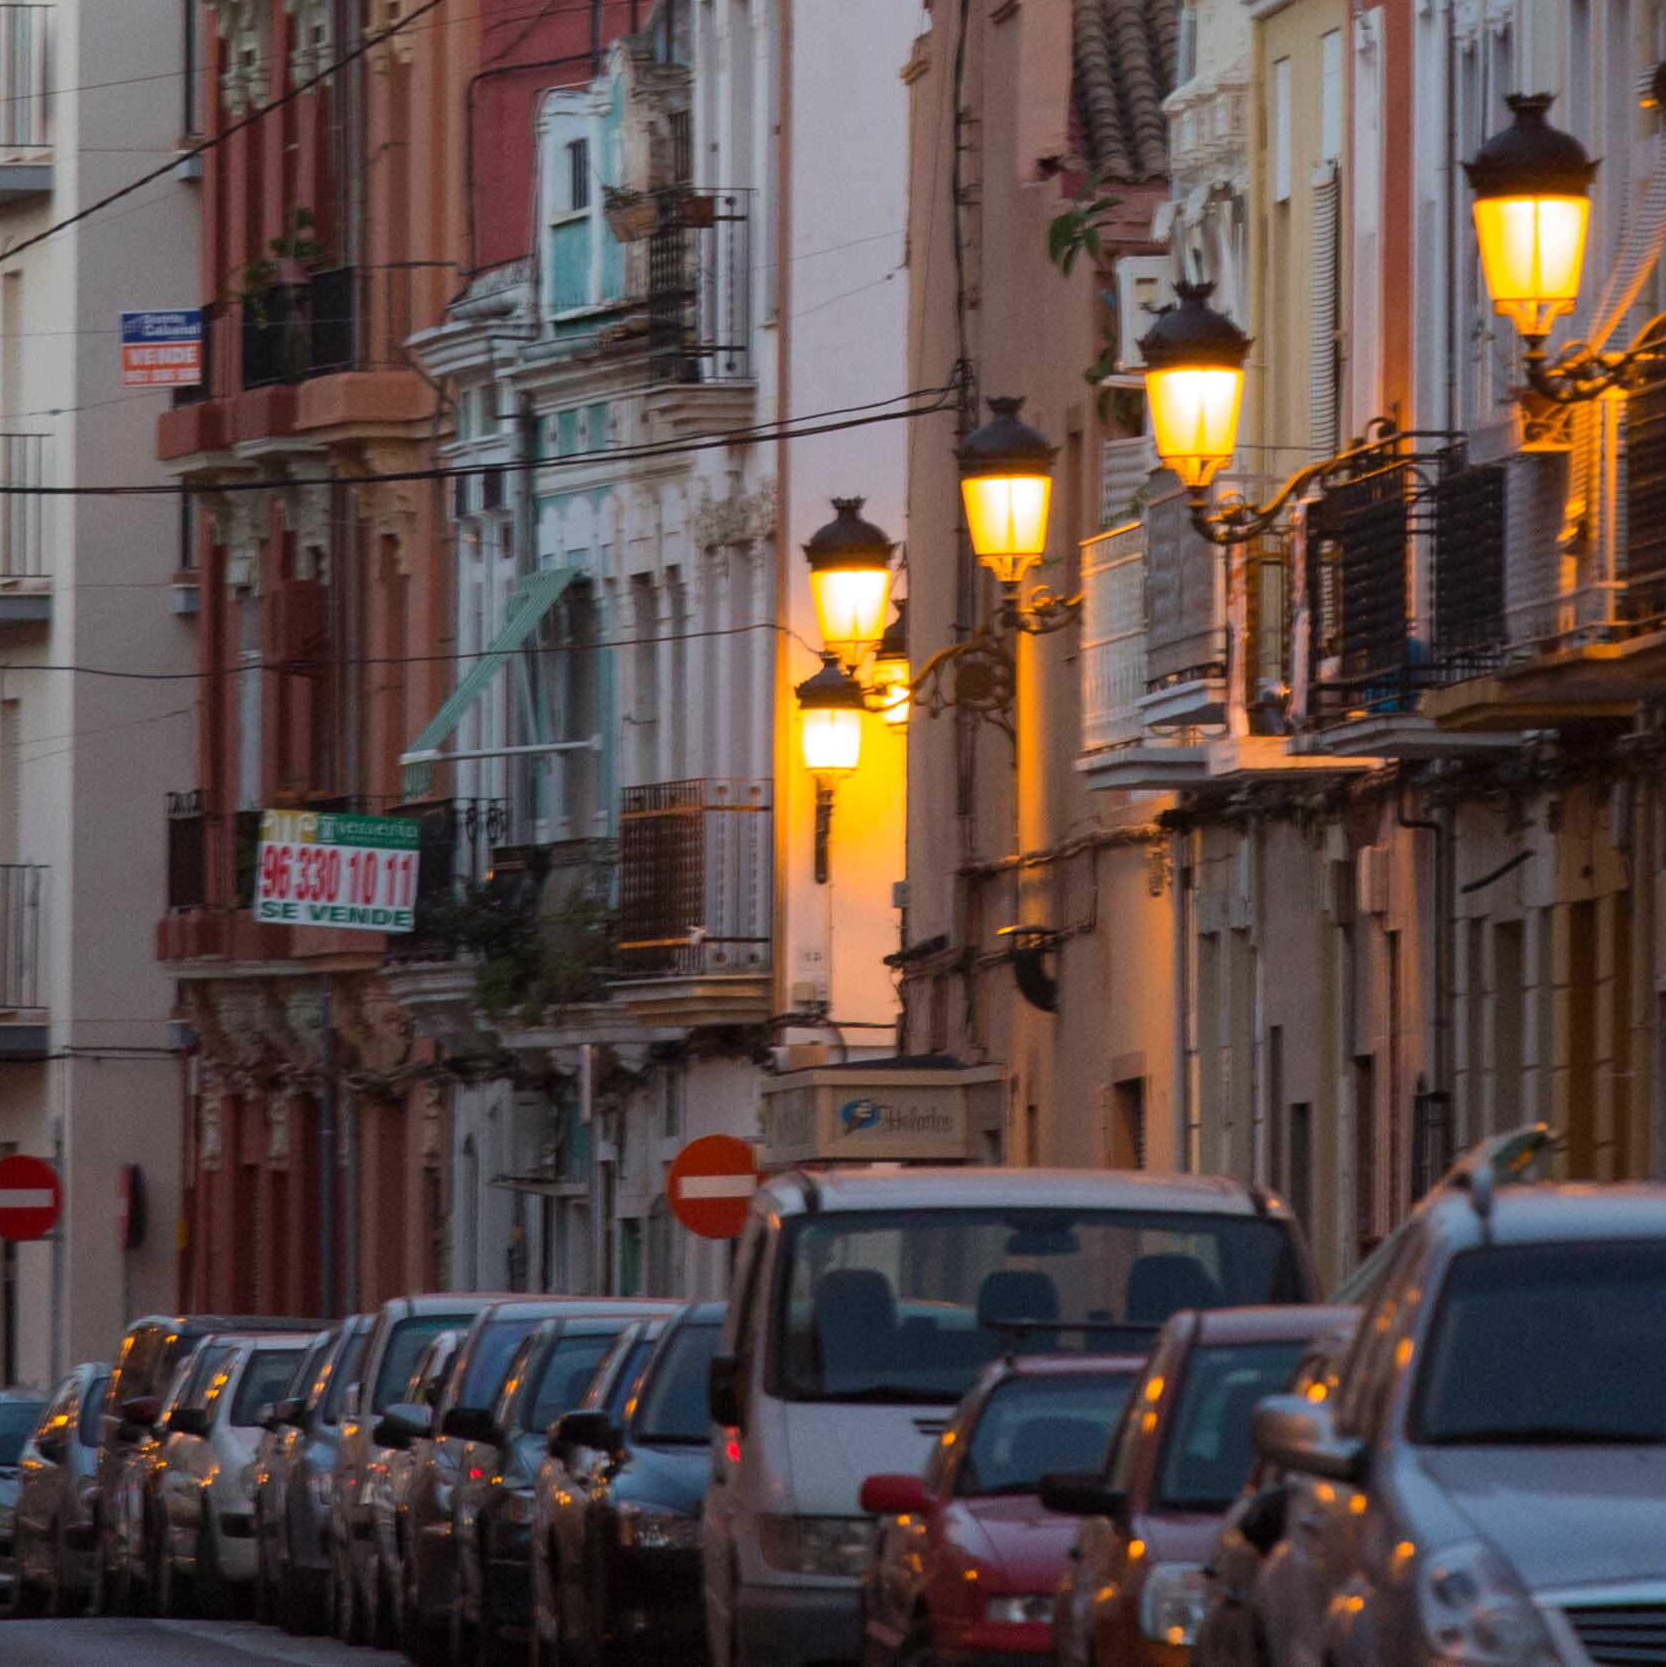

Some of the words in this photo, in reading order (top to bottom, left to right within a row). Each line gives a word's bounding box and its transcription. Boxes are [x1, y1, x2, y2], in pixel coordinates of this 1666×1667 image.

[262, 845, 292, 899] 96
[295, 847, 341, 902] 330
[349, 851, 378, 905] 10
[385, 853, 413, 906] 11
[260, 901, 299, 919] SE
[308, 904, 414, 927] VENDE
